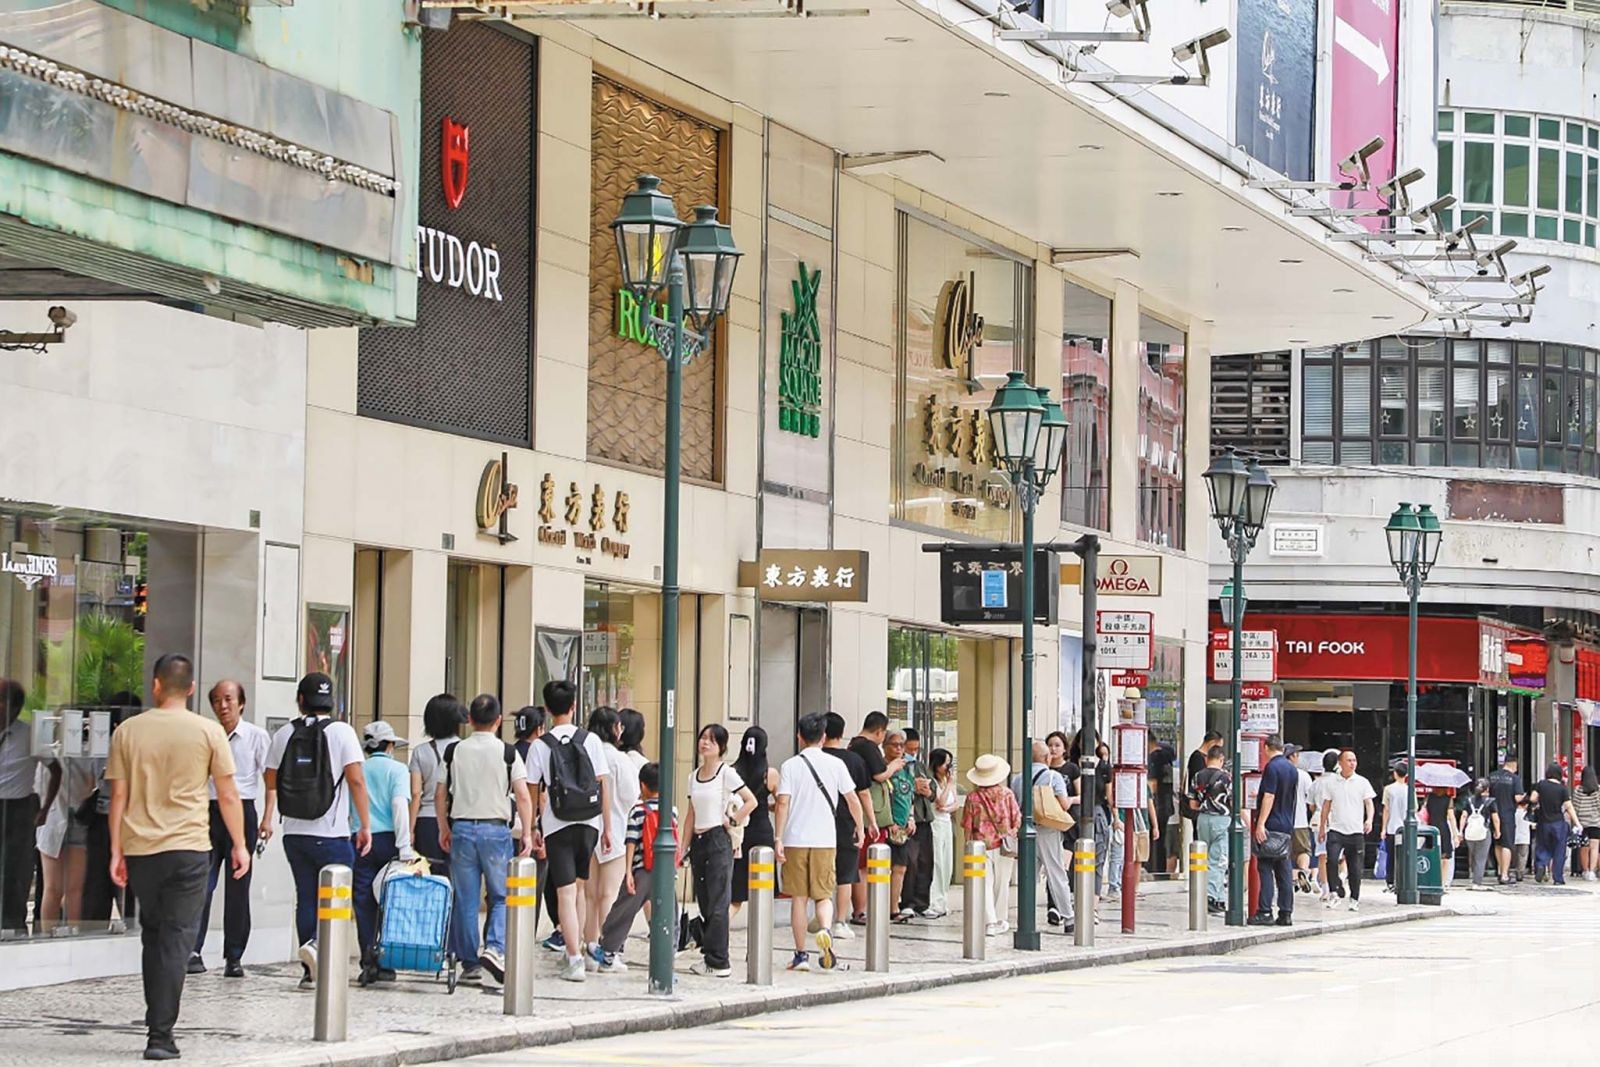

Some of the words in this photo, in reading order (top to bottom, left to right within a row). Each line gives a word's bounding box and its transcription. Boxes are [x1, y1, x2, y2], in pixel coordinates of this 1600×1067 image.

[784, 367, 821, 408] SQUARE
[762, 563, 855, 588] 東方表行
[1285, 641, 1312, 653] TAI
[1318, 641, 1365, 654] FOOK
